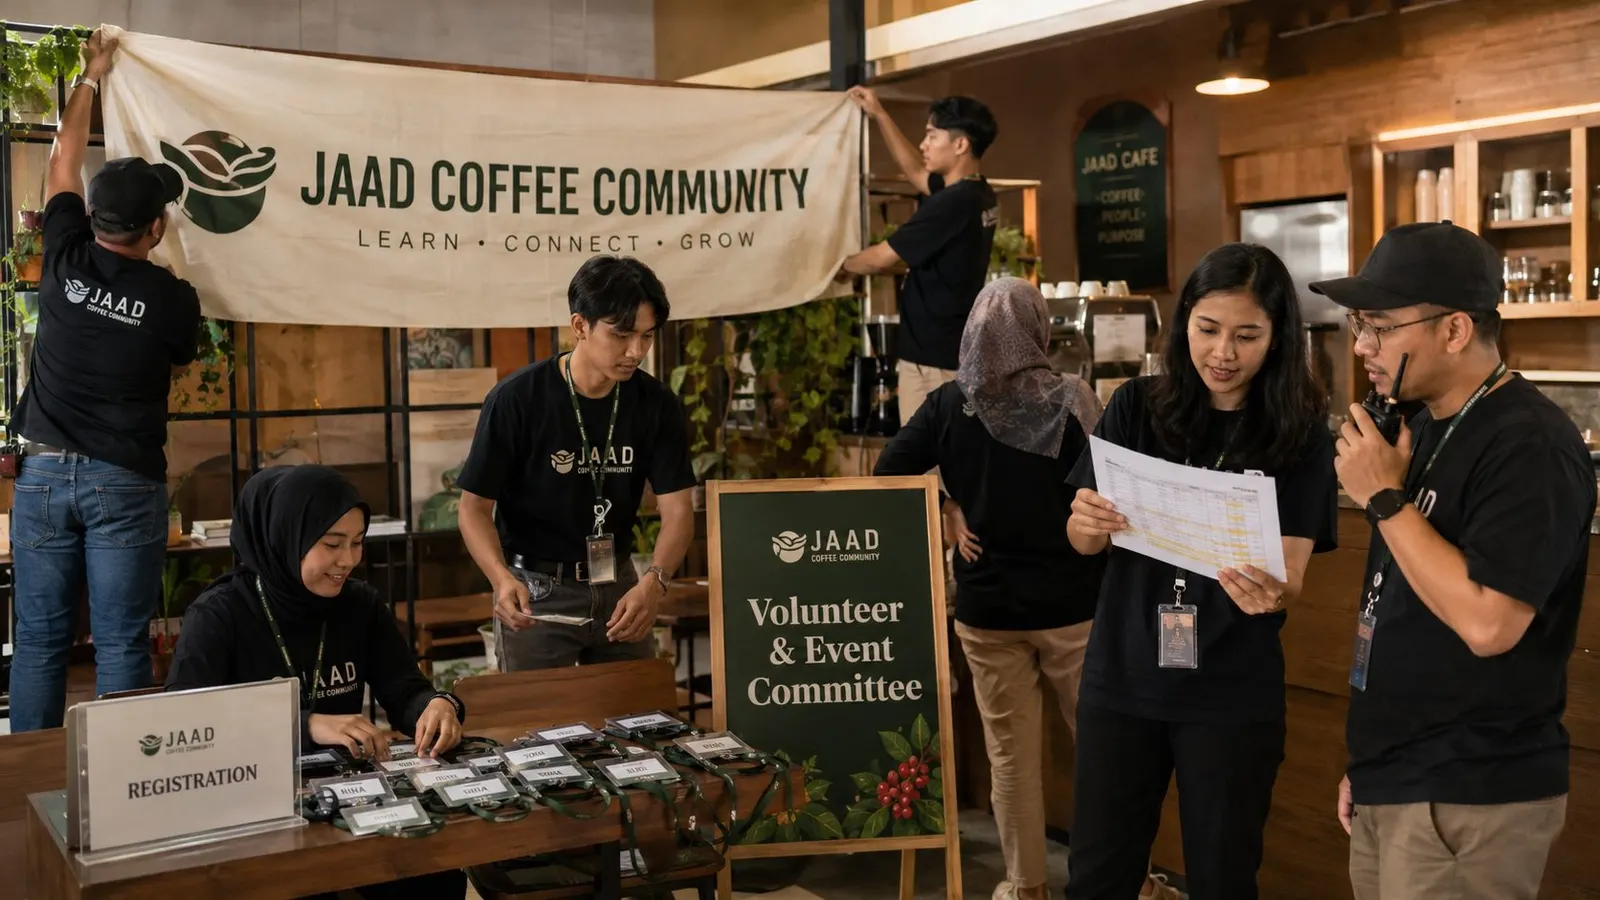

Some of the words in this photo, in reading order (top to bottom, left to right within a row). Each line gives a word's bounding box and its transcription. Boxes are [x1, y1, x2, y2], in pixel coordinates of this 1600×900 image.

[1081, 153, 1118, 174] JAAD
[1121, 147, 1159, 168] CAFE
[300, 151, 415, 209] JAAD
[431, 160, 579, 216] COFFEE
[593, 167, 809, 216] COMMUNITY
[358, 229, 459, 250] LEARN
[504, 235, 640, 254] CONNECT
[680, 231, 755, 250] GROW
[86, 303, 108, 316] COFFEE
[108, 311, 141, 327] COMMUNITY
[90, 288, 146, 318] JAAD
[578, 446, 634, 465] JAAD
[600, 466, 633, 474] OMMUNITY
[811, 529, 879, 551] JAAD
[811, 554, 838, 562] COFFEE
[839, 553, 880, 562] COMMUNITY
[747, 596, 904, 627] Volunteer
[769, 637, 796, 666] &
[804, 636, 895, 665] Event
[747, 673, 923, 706] Committee
[165, 726, 215, 748] JAAD
[128, 764, 258, 799] REGISTRATION
